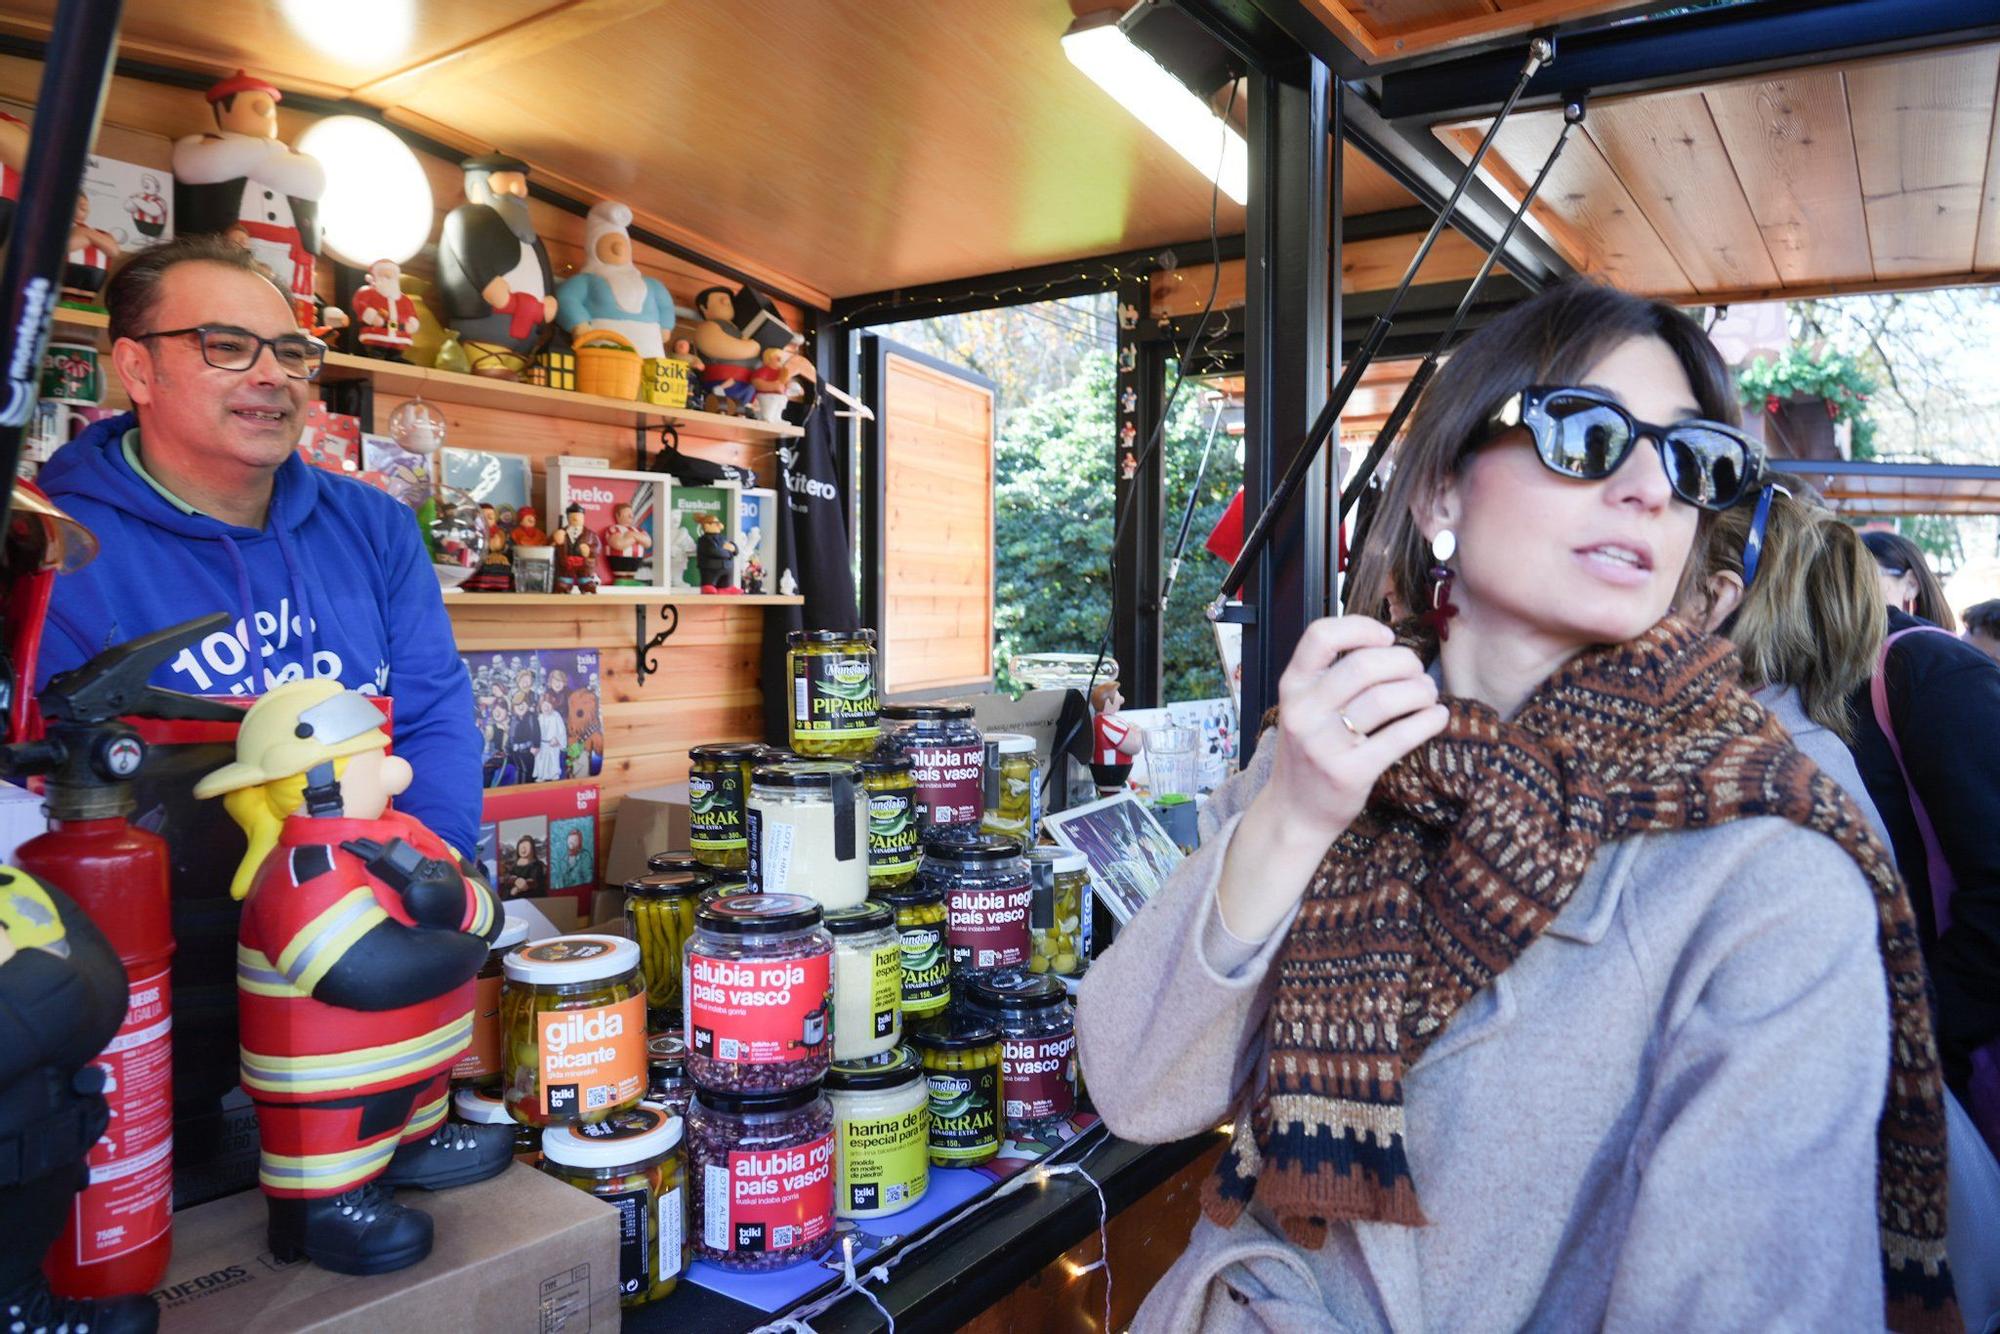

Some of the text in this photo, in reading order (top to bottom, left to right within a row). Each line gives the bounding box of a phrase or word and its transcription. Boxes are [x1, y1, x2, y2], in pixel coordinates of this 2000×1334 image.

[577, 655, 597, 666] txiki
[944, 767, 979, 780] vasco
[577, 790, 597, 801] txiki
[951, 892, 1005, 910] alubia
[951, 908, 1024, 926] país vasco
[693, 960, 804, 990] alubia roja
[693, 983, 791, 1007] país vasco
[545, 1010, 623, 1051] gilda
[1002, 1035, 1075, 1059] bia negra
[546, 1047, 616, 1072] picante
[1015, 1059, 1060, 1074] vasco
[551, 1088, 574, 1099] txiki
[551, 1098, 563, 1108] to
[849, 1120, 899, 1137] harina
[902, 1112, 917, 1129] de
[849, 1133, 897, 1149] especial
[899, 1127, 919, 1144] para
[735, 1151, 805, 1177] alubia
[809, 1137, 835, 1166] roja
[735, 1163, 829, 1199] país vasco
[854, 1187, 875, 1197] txiki
[854, 1195, 865, 1204] to
[739, 1227, 761, 1238] txiki
[739, 1236, 750, 1246] to
[152, 1265, 247, 1301] FUEGOS
